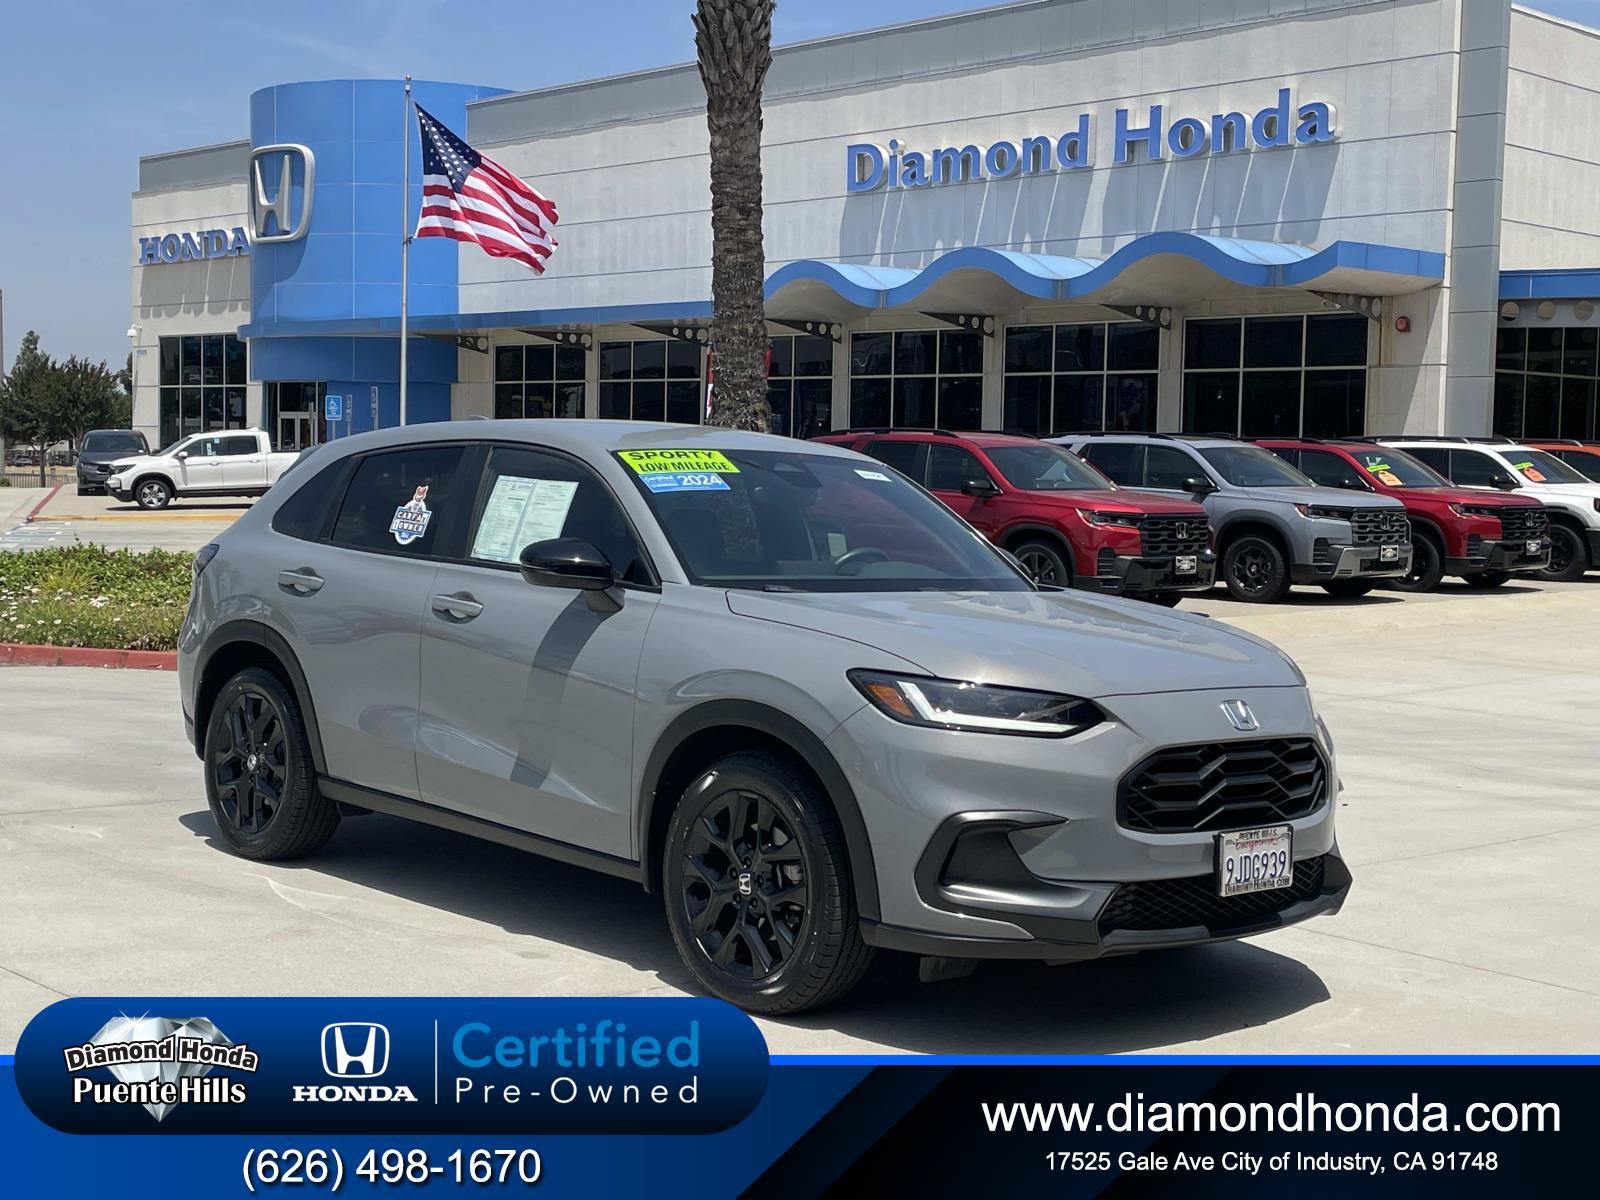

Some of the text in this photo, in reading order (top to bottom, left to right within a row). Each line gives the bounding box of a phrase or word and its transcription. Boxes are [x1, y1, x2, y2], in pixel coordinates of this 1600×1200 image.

[847, 88, 1342, 193] Diamond Honda
[139, 227, 250, 265] HONDA
[628, 450, 713, 460] SPORTY
[639, 461, 729, 472] LOW MILEAGE
[677, 474, 722, 486] 2024
[1226, 850, 1287, 884] 9JDG939
